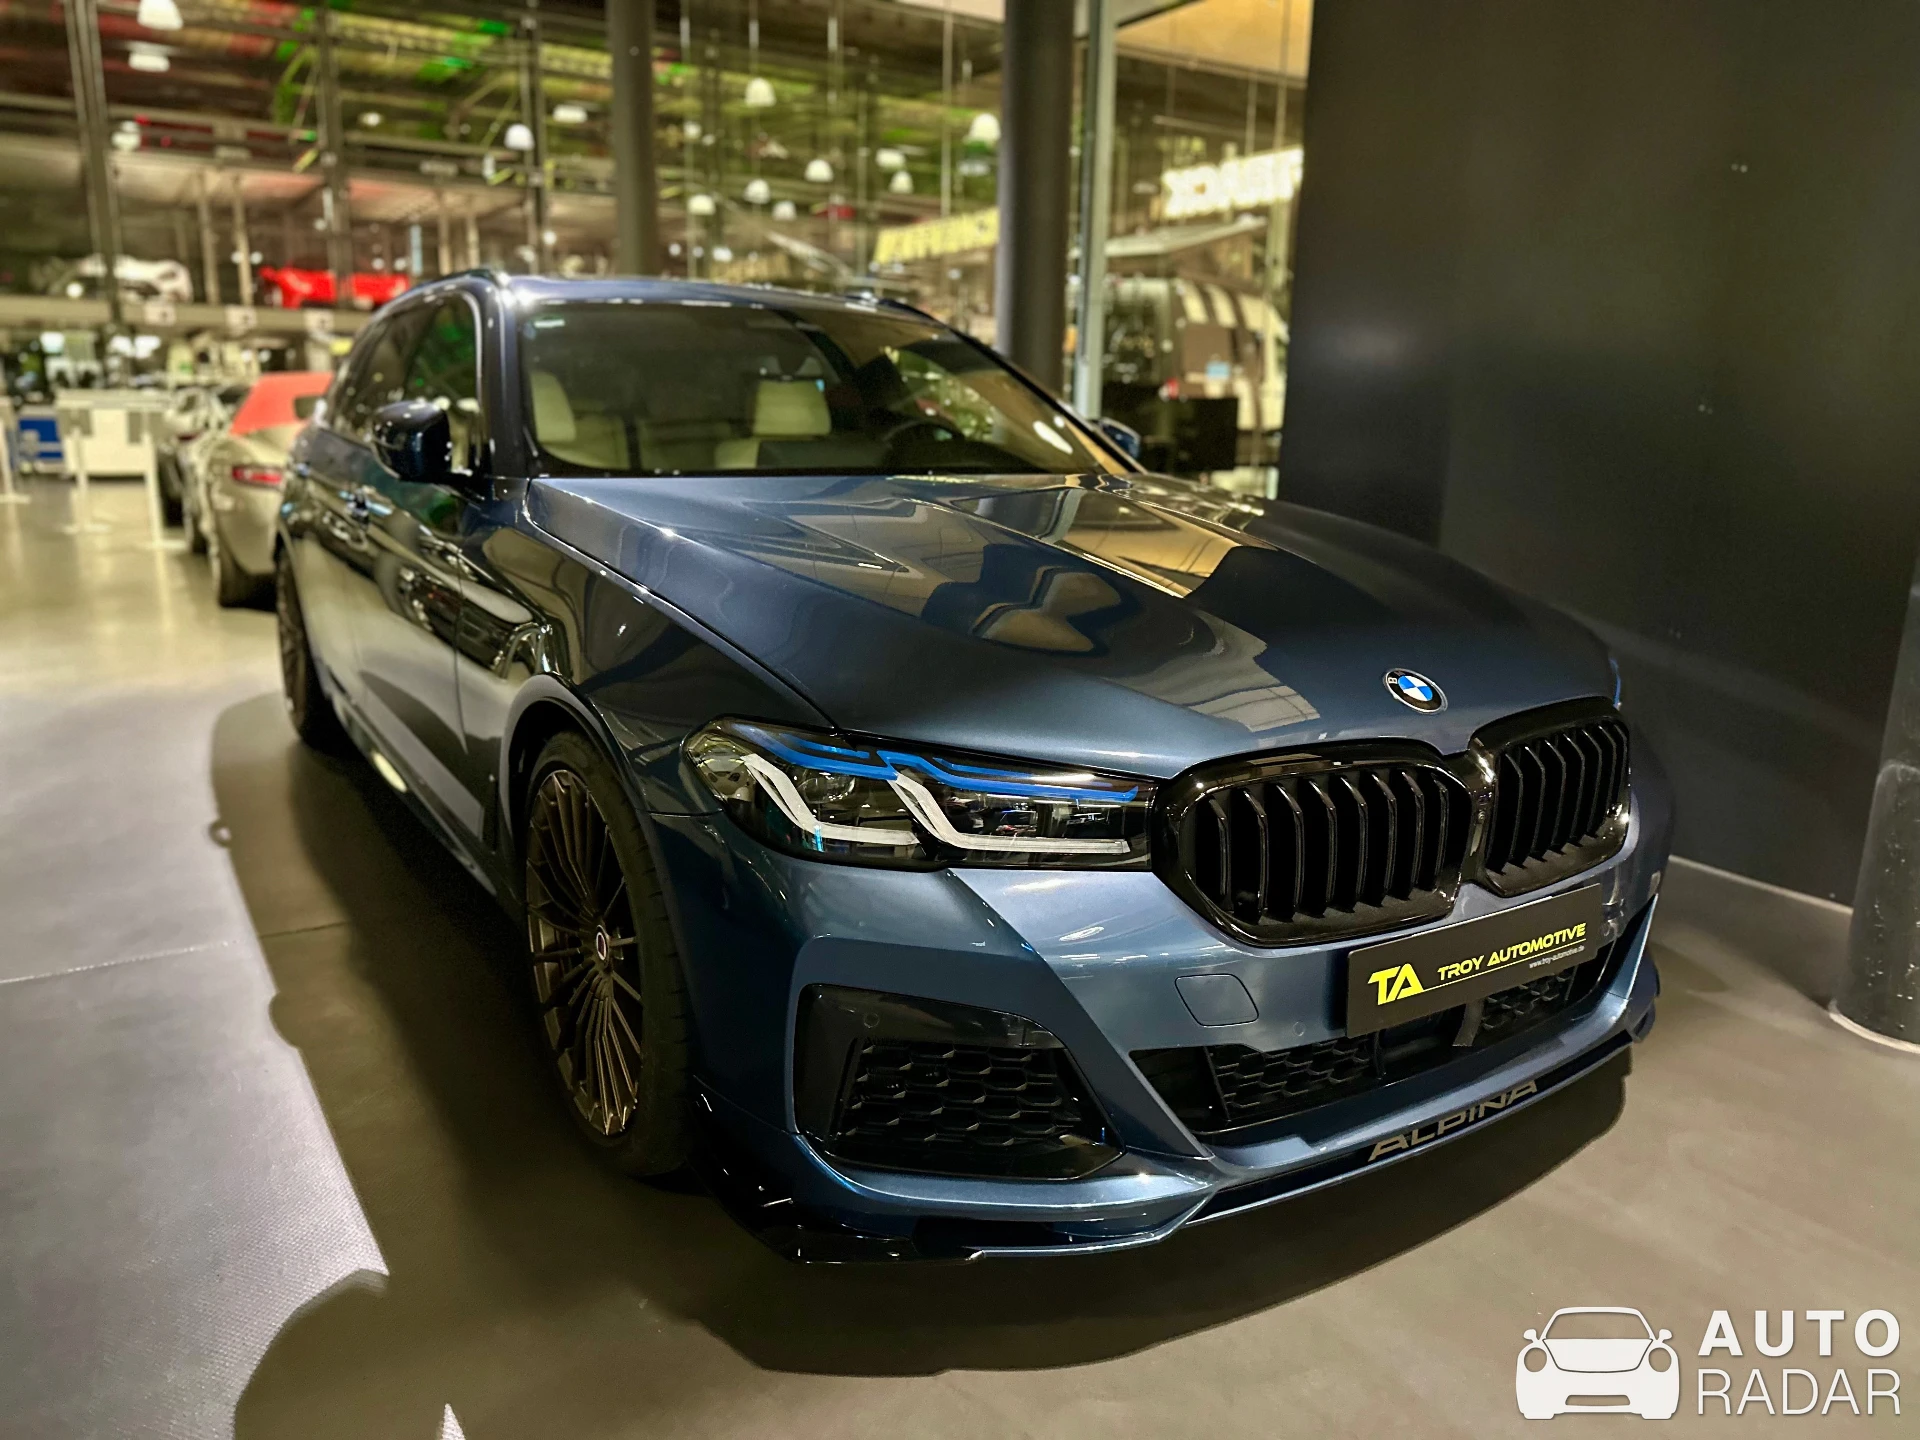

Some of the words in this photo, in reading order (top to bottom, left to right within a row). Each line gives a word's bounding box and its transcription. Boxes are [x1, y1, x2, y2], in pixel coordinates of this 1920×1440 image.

[1437, 954, 1485, 981] TROY
[1487, 922, 1587, 968] AUTOMOTIVE
[1367, 962, 1424, 1006] TA
[1367, 1080, 1538, 1163] ALPINA
